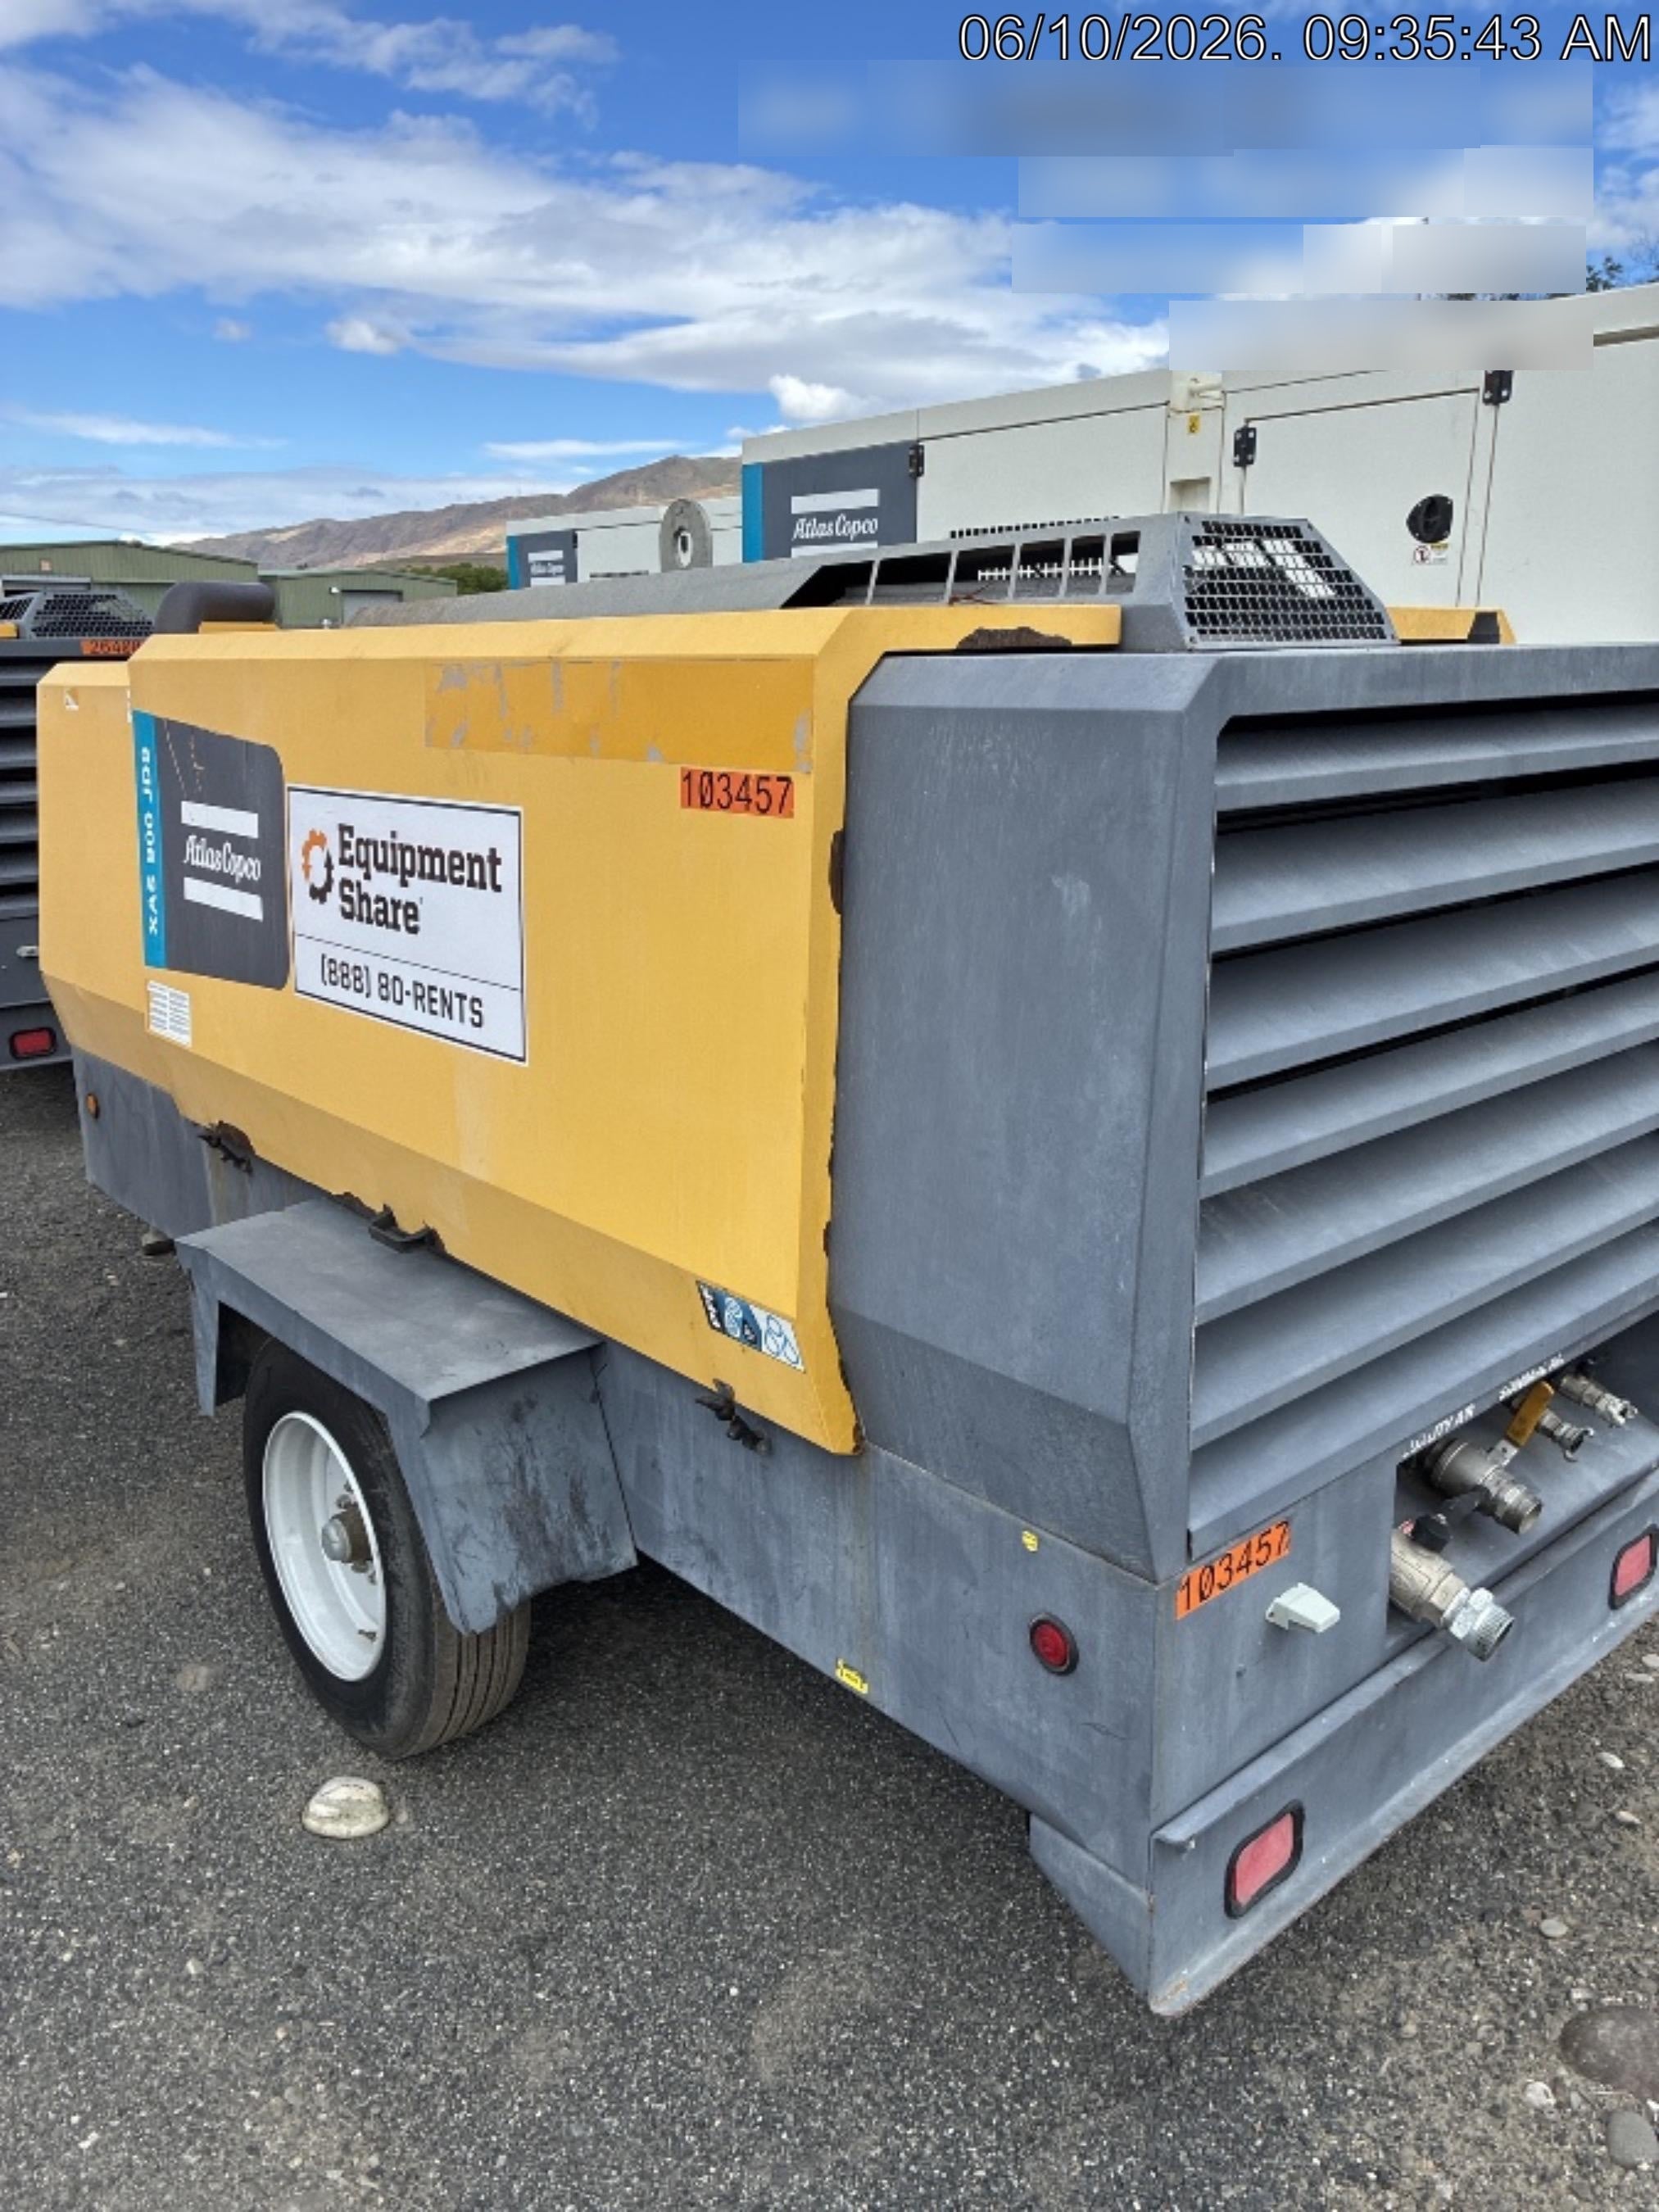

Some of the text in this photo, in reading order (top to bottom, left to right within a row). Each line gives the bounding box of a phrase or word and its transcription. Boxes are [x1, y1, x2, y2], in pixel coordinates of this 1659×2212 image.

[791, 513, 878, 541] Atlas Copco
[682, 770, 792, 814] 103457
[184, 834, 262, 883] Atlas Copco
[338, 823, 502, 893] Equipment
[338, 877, 420, 935] Share
[320, 953, 483, 1028] (888) 80-RENTS
[1180, 1521, 1290, 1611] 103457
